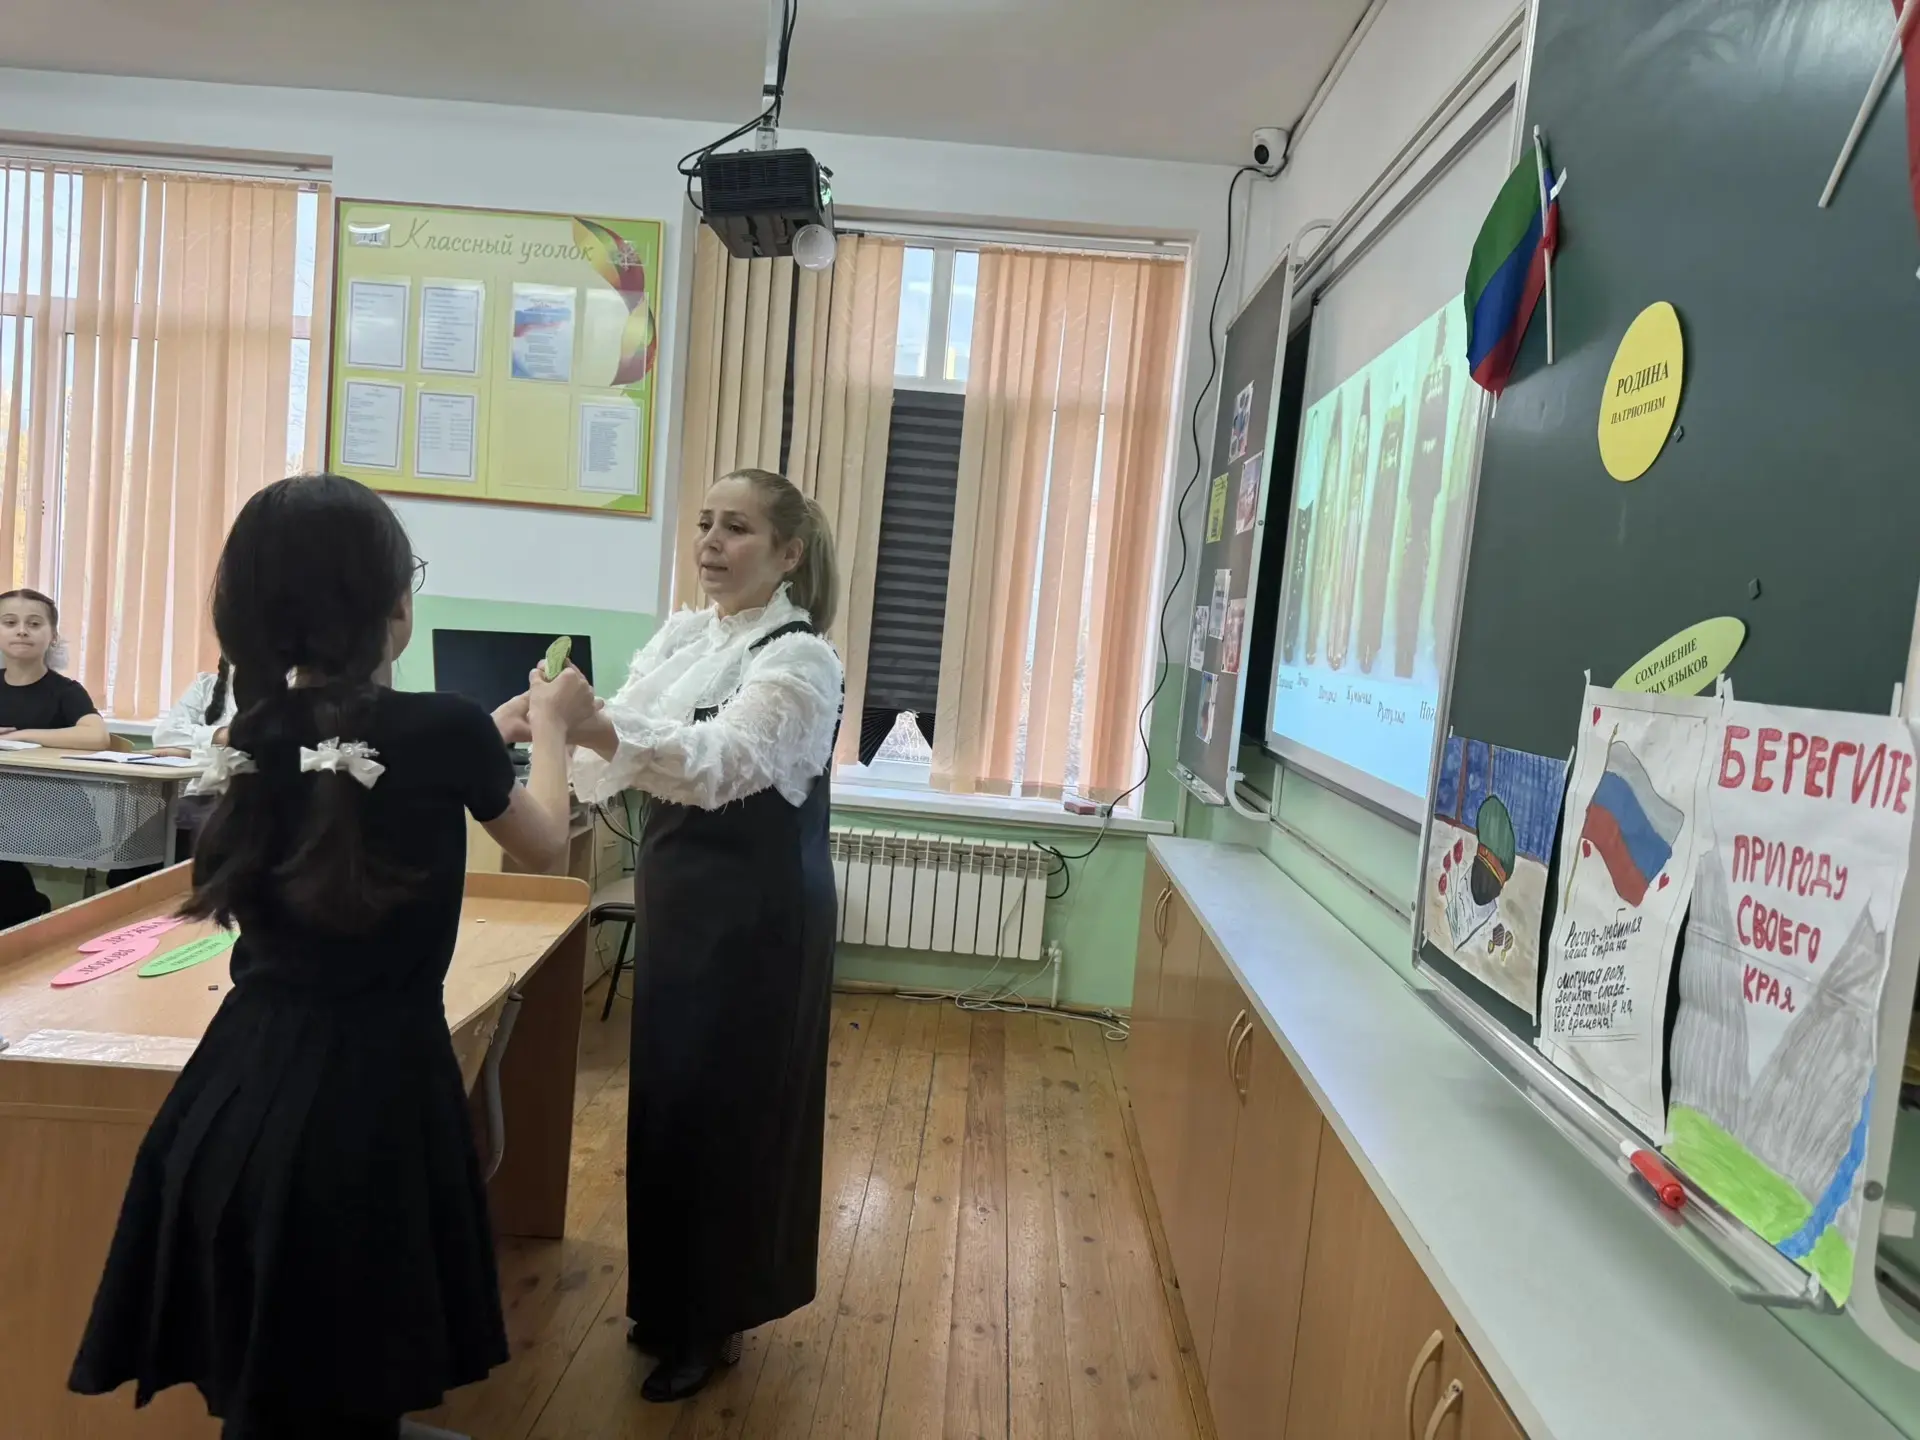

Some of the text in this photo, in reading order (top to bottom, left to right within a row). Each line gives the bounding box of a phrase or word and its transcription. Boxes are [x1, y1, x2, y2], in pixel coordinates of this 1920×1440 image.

[394, 217, 595, 265] Классный уголок
[1616, 360, 1668, 397] РОДИНА
[1611, 396, 1665, 424] ПАТРИОТИЗМ
[1635, 638, 1698, 684] СОХРАНЕНИЕ
[1667, 655, 1708, 689] ЯЗЫКОВ
[1718, 725, 1913, 814] БЕРЕГИТЕ
[1732, 834, 1848, 900] ПРИРОДУ
[1737, 895, 1821, 963] СВОЕГО
[1743, 963, 1796, 1013] КРАЯ
